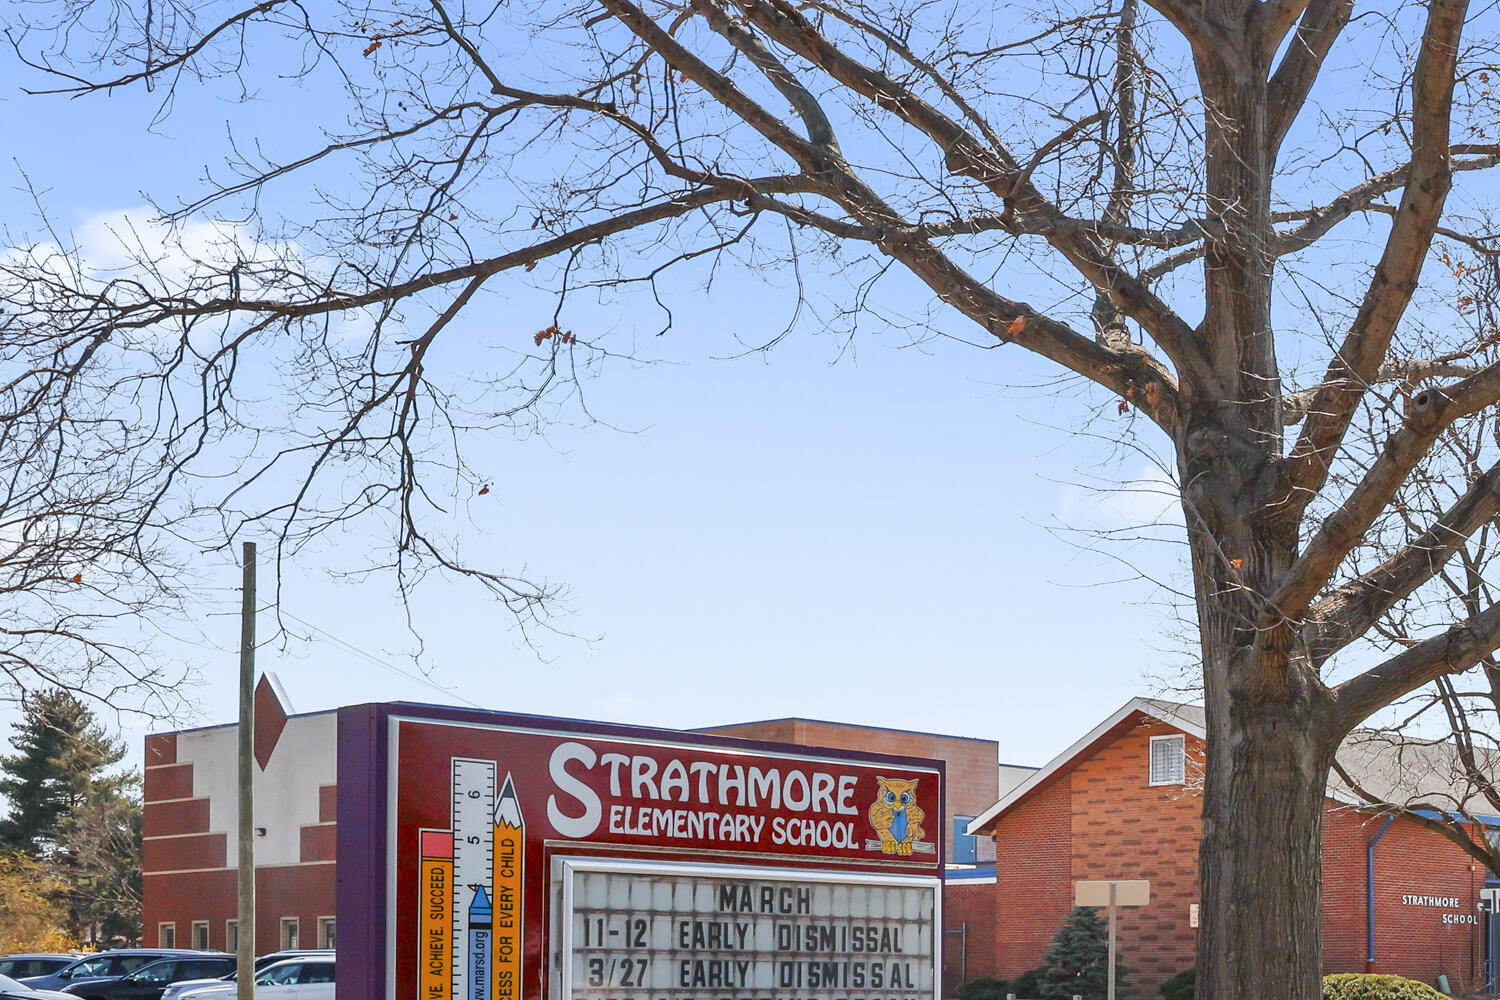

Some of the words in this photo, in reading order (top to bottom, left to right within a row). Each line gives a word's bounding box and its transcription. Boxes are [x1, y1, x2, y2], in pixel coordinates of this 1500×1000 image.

[467, 790, 480, 799] 6
[546, 741, 859, 838] STRATHMORE
[467, 835, 480, 845] 5
[609, 805, 765, 843] ELEMENTARY
[772, 816, 859, 849] SCHOOL
[501, 838, 514, 878] CHILD
[430, 865, 445, 920] SUCCEED.
[500, 885, 514, 929] EVERY
[720, 885, 810, 914] MARCH
[1402, 894, 1460, 908] STRATHMORE
[1442, 913, 1478, 925] SCHOOL
[430, 926, 444, 976] ACHIEVE.
[499, 936, 513, 964] FOR
[584, 918, 647, 948] 11-12
[679, 921, 749, 950] EARLY
[778, 924, 903, 953] DISMISSAL
[589, 958, 648, 987] 3/27
[680, 960, 749, 987] EARLY
[780, 961, 914, 988] DISMISSAL
